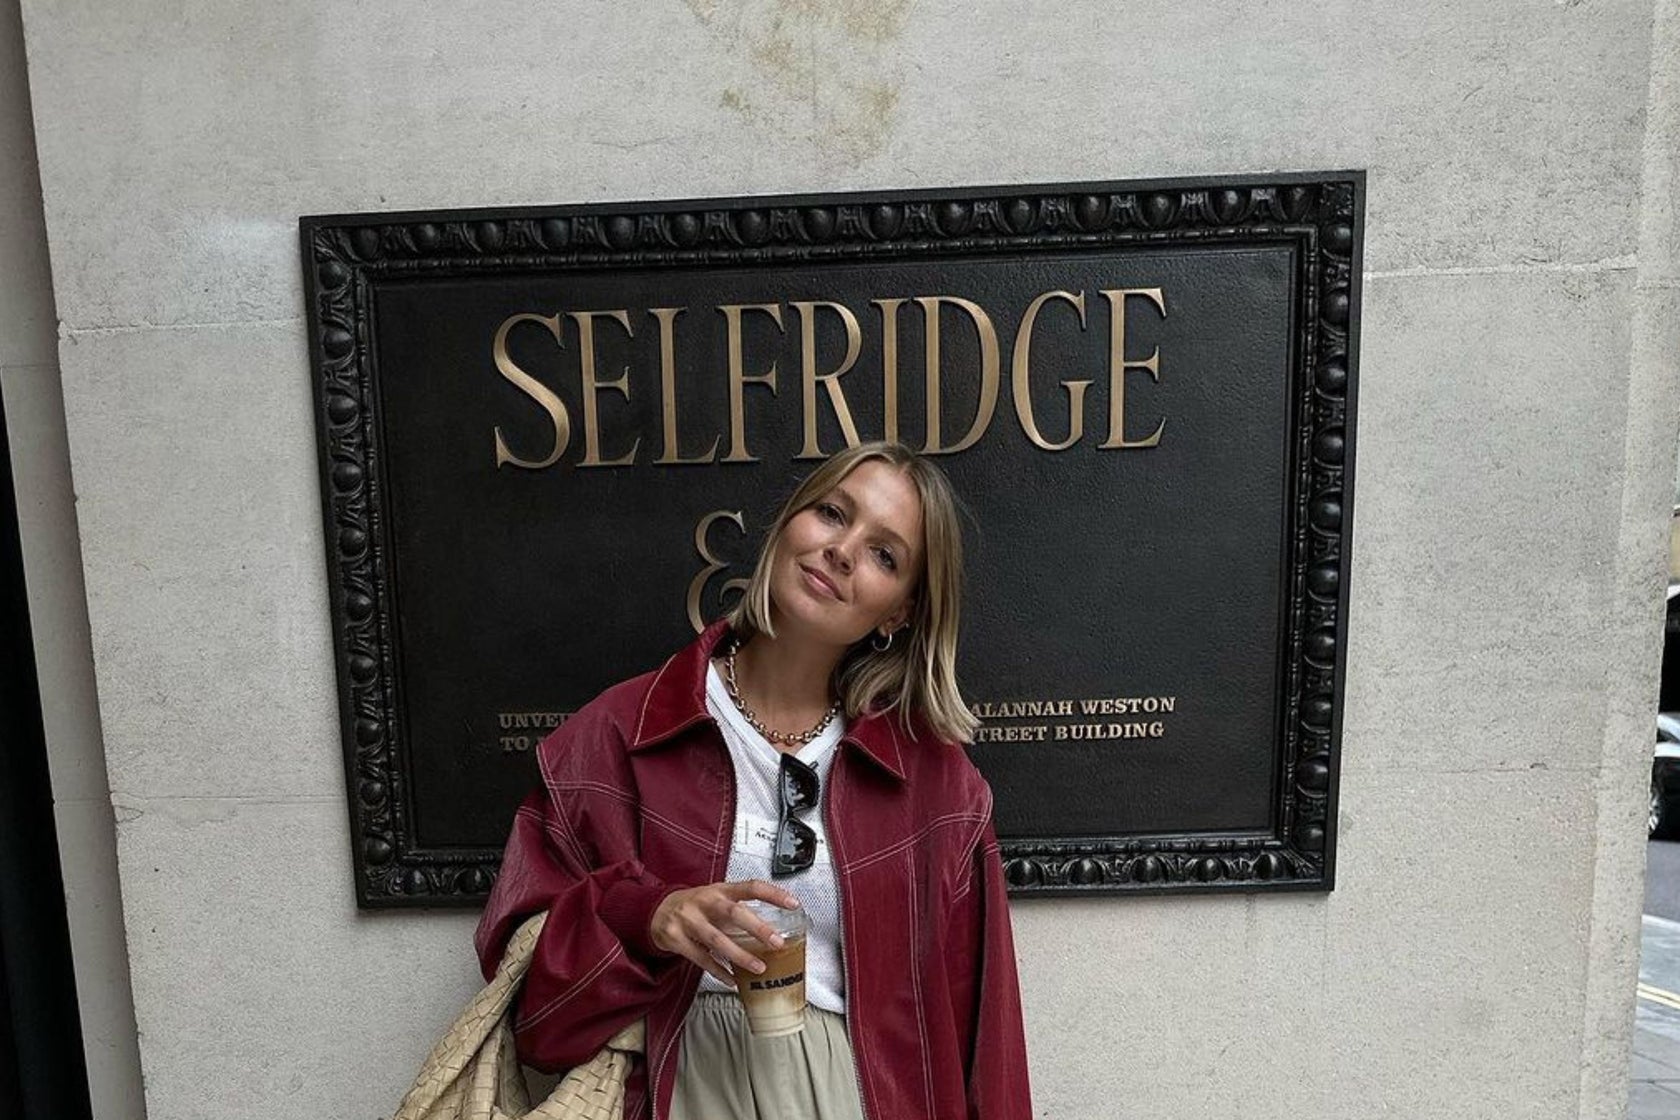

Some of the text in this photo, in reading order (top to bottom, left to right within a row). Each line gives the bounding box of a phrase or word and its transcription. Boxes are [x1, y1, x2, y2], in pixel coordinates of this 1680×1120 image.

[491, 287, 1168, 470] SELFRIDGE
[686, 509, 751, 635] &
[498, 697, 1177, 729] UNVEI ALANNAH WESTON
[500, 735, 529, 752] TO
[969, 726, 1048, 743] TREET
[1055, 721, 1165, 741] BUILDING
